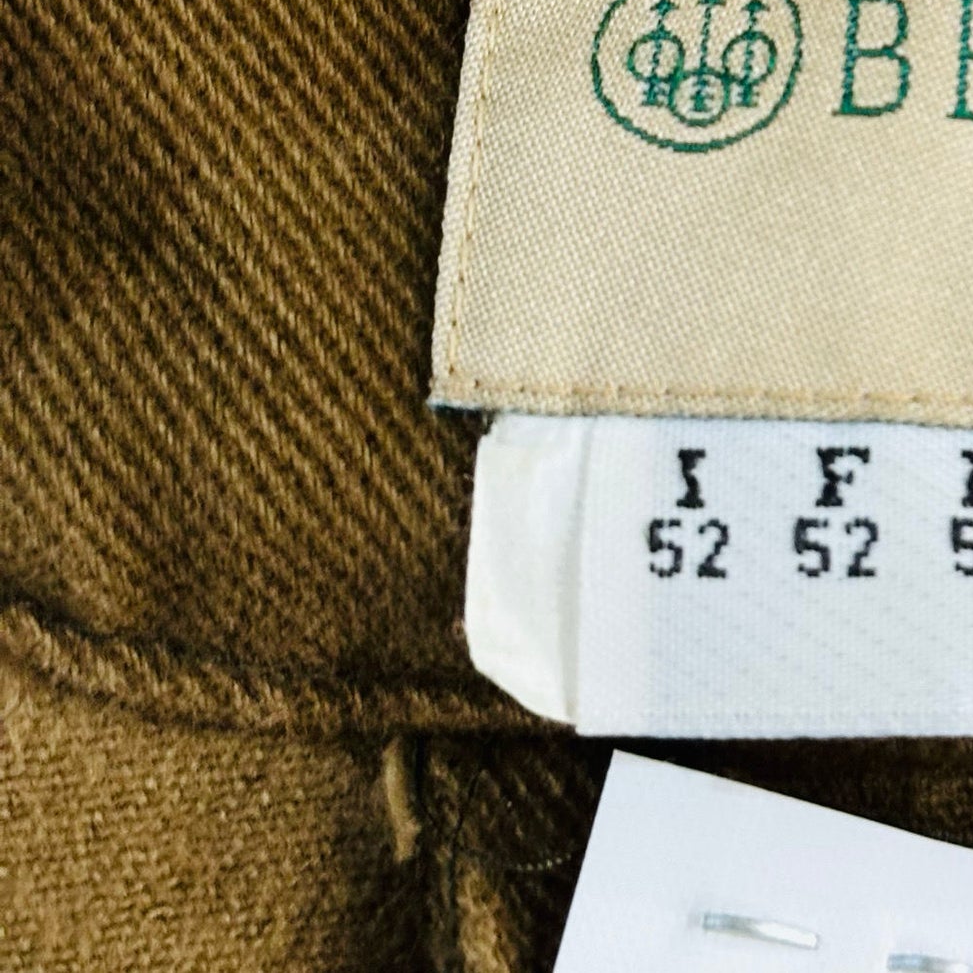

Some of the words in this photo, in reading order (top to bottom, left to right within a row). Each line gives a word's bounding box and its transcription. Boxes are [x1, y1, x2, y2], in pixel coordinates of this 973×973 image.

[676, 448, 706, 509] I
[816, 447, 870, 508] F
[648, 518, 729, 579] 52
[794, 518, 878, 578] 52
